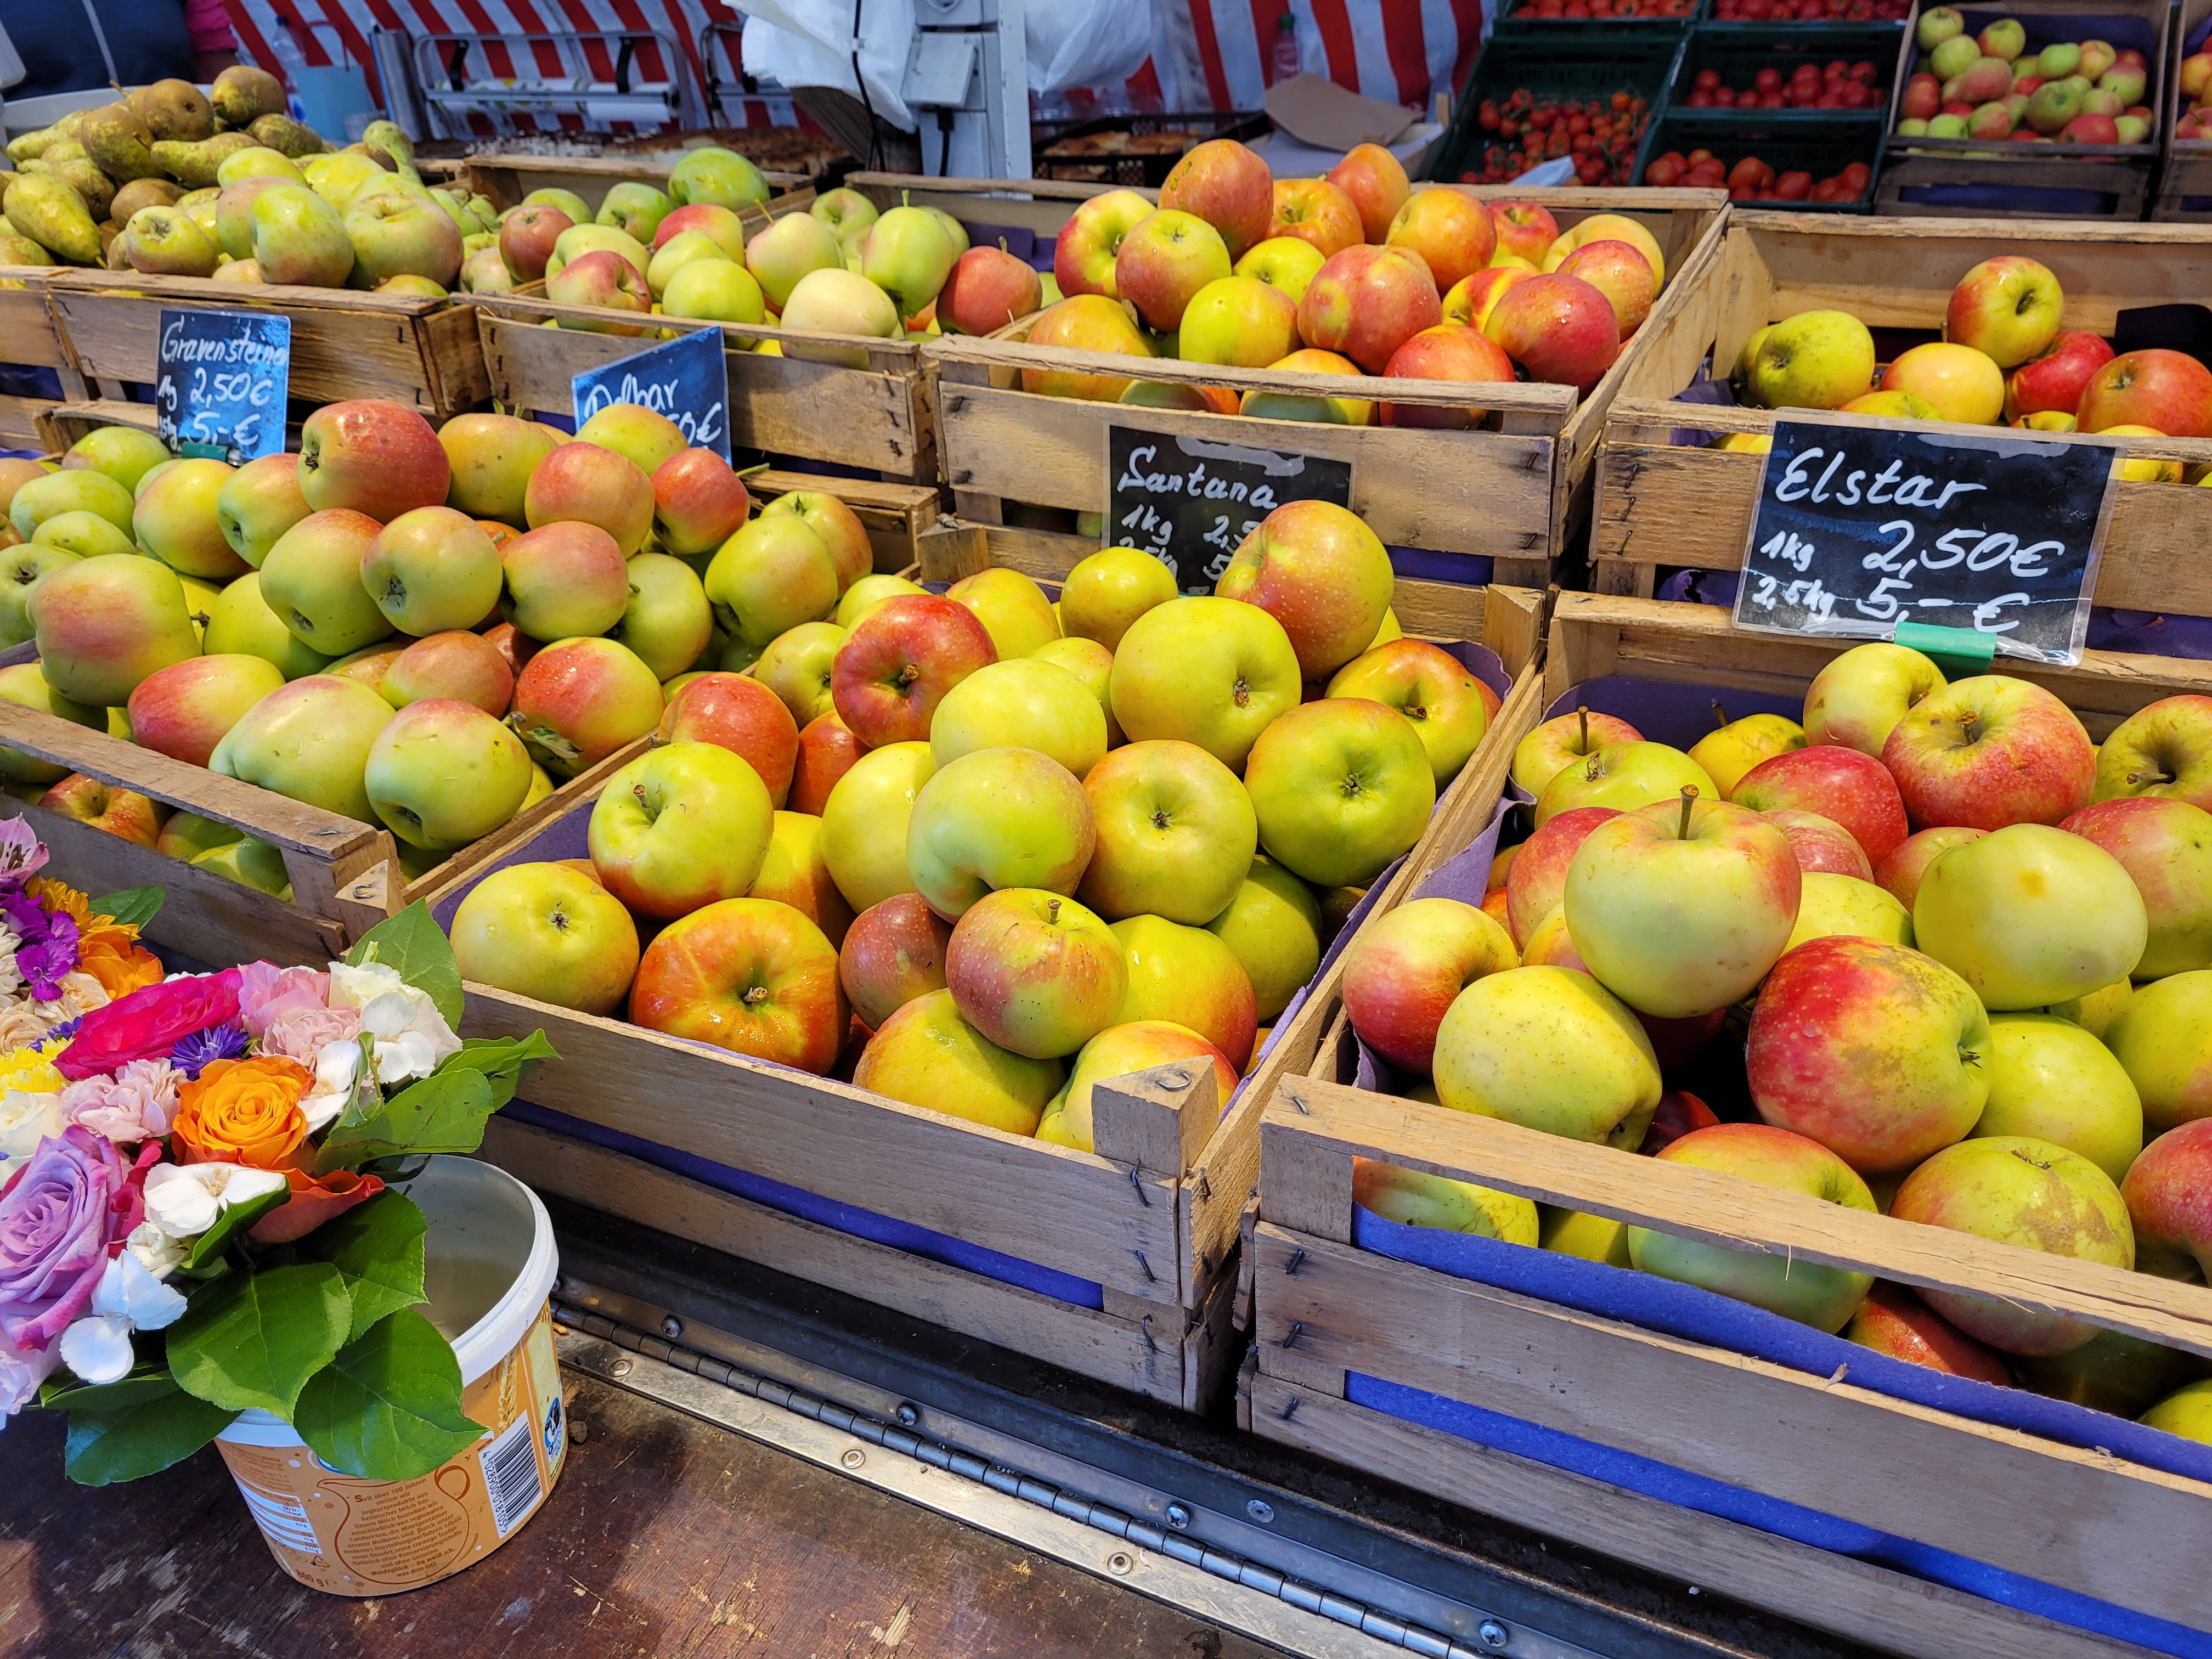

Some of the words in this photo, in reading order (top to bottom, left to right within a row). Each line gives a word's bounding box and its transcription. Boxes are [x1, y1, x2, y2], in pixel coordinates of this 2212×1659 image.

[1116, 444, 1278, 510] Santana
[1775, 447, 1988, 510] Elstar
[1121, 504, 1173, 545] 1kg
[1760, 530, 1815, 572] 1kg
[354, 1494, 373, 1503] Seit
[405, 1478, 427, 1490] Jahren
[376, 1496, 398, 1505] stellen
[360, 1509, 397, 1522] heimischer
[398, 1503, 416, 1513] Milch
[362, 1496, 415, 1515] Joghurtprodukte
[377, 1516, 396, 1525] Milch
[396, 1506, 426, 1520] beziehen
[427, 1500, 438, 1509] wir
[351, 1523, 396, 1536] ausschließlich
[410, 1505, 444, 1522] regionalen
[371, 1536, 399, 1545] Molkerei
[417, 1522, 436, 1533] Durch
[437, 1514, 454, 1525] unser
[401, 1510, 448, 1532] Miteigentümer
[374, 1526, 443, 1551] Herstellungsverfahren
[398, 1530, 462, 1558] Konservierungsstoffe
[412, 1536, 437, 1548] cremige
[370, 1564, 409, 1576] Weideglück
[426, 1553, 443, 1562] weiß
[296, 1569, 314, 1583] 800
[316, 1578, 324, 1587] g
